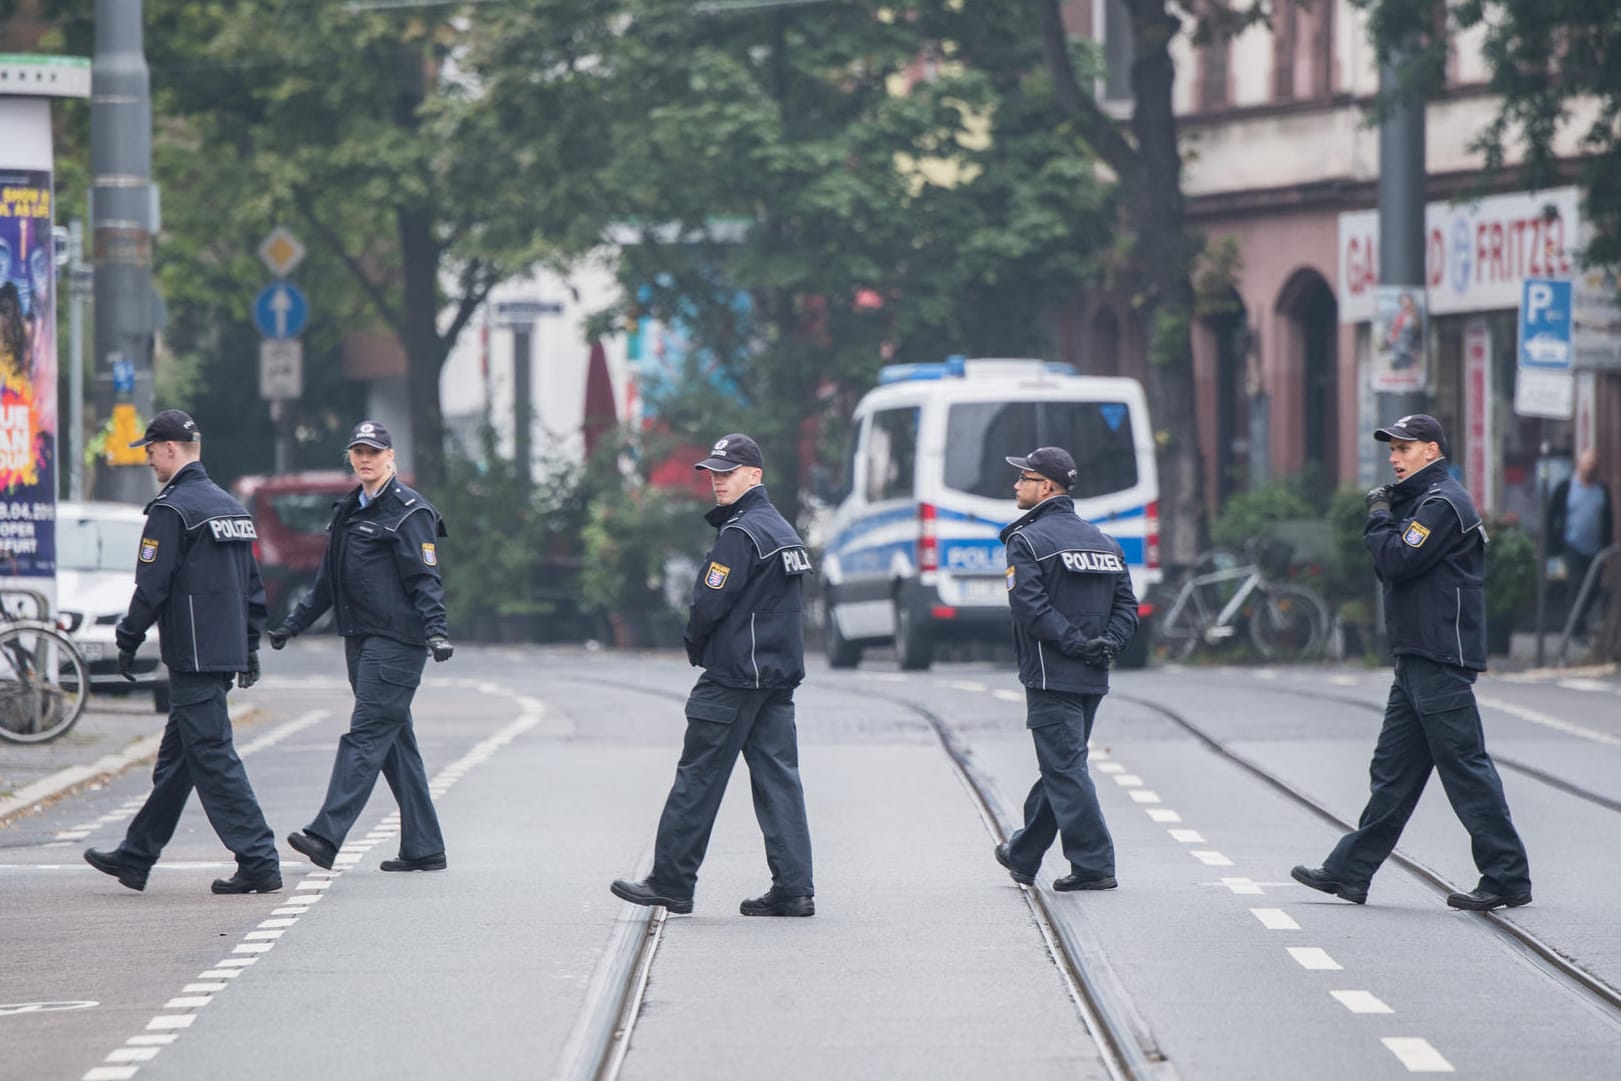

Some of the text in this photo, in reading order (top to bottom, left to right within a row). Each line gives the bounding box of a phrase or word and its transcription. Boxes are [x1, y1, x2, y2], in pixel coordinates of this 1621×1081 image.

[1476, 215, 1570, 285] FRITZEL
[1527, 283, 1553, 324] P
[1061, 552, 1123, 571] POLIZEI
